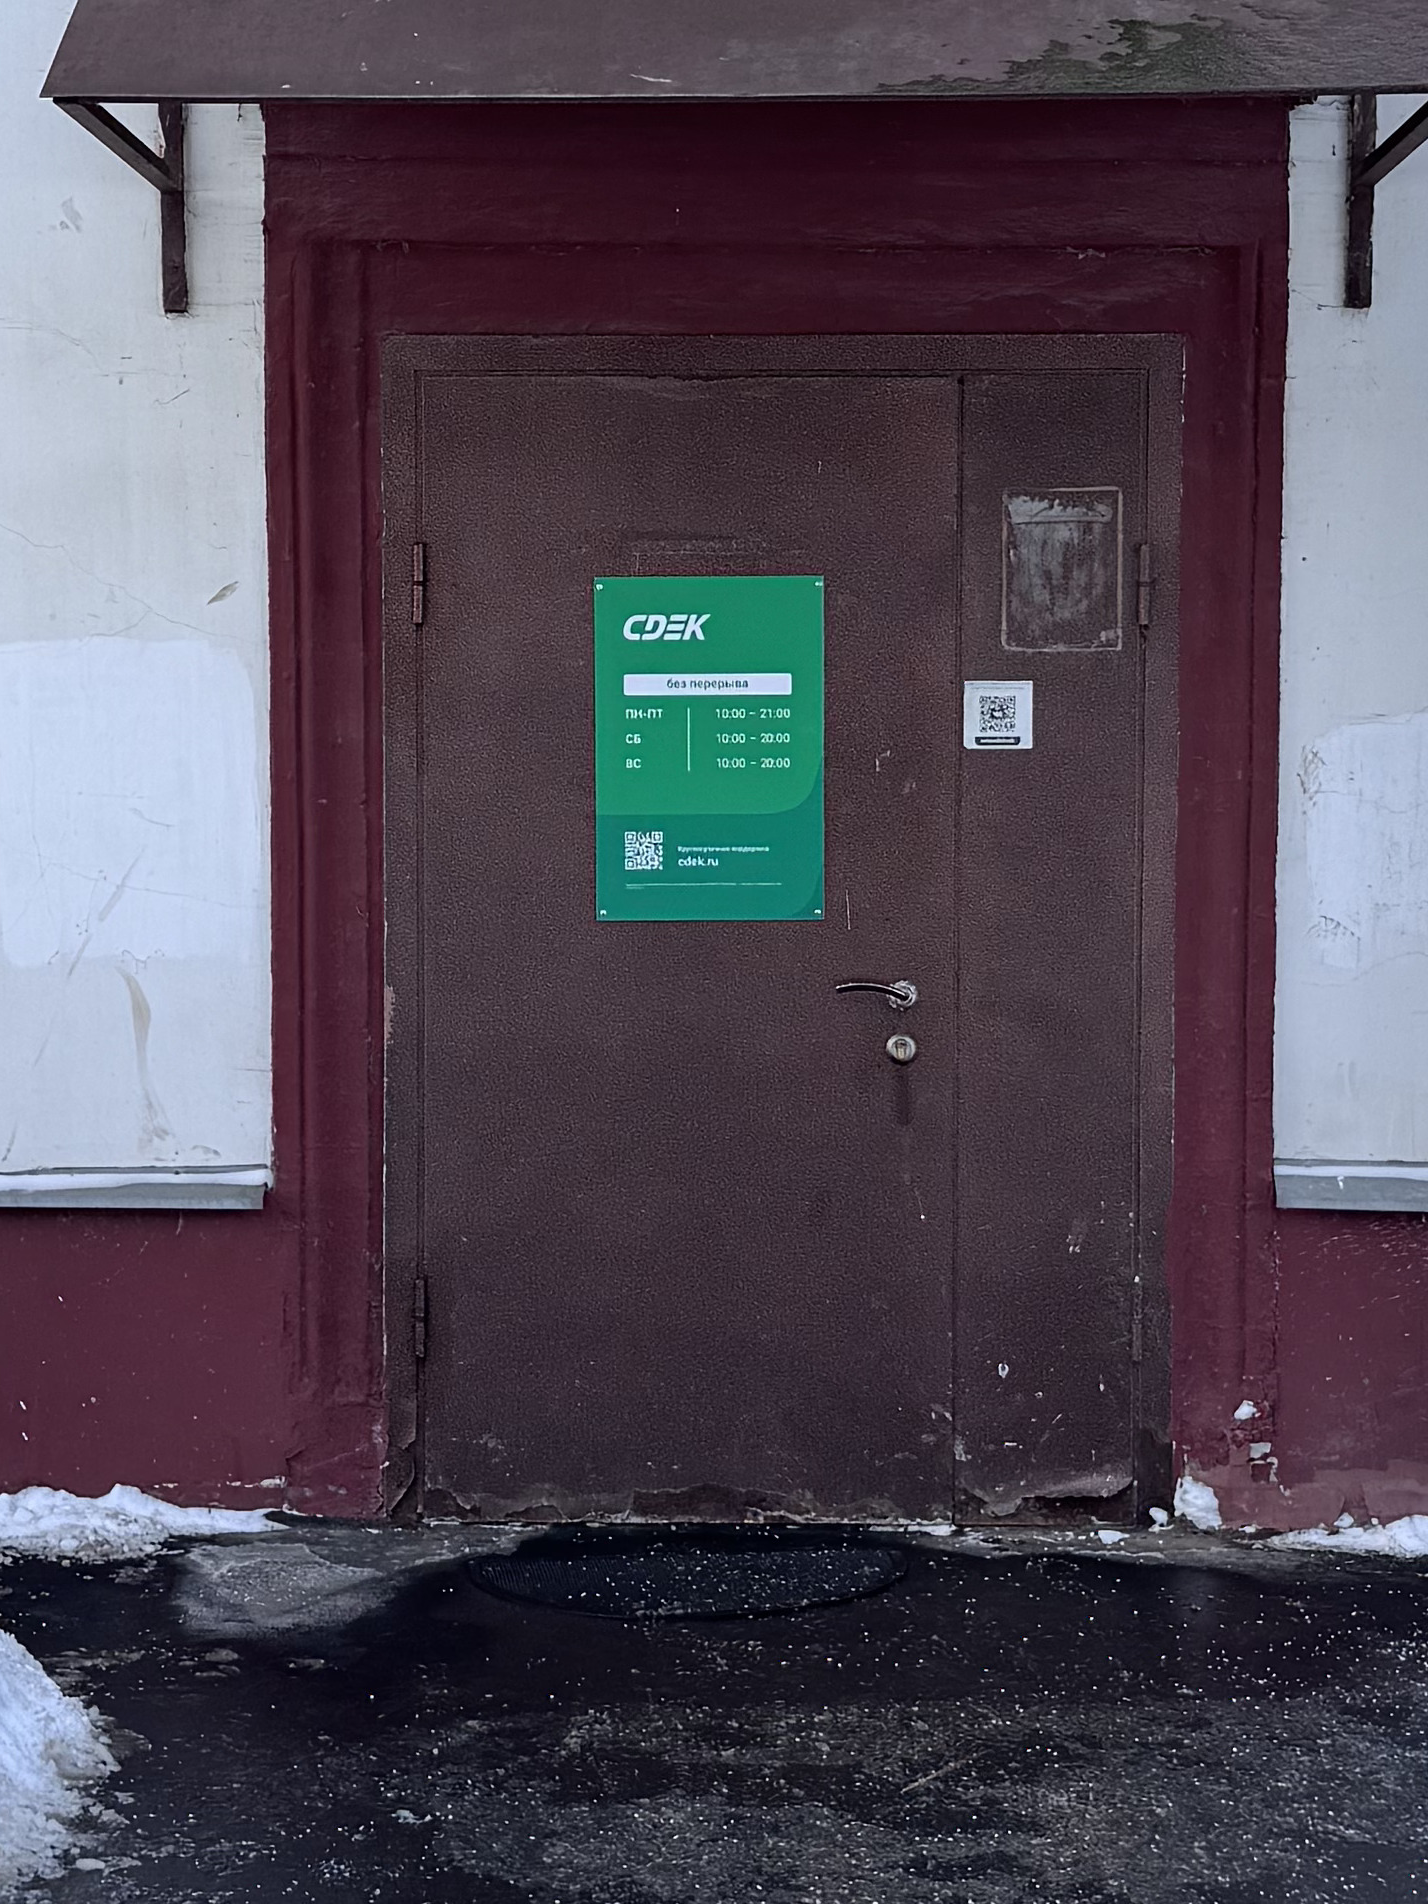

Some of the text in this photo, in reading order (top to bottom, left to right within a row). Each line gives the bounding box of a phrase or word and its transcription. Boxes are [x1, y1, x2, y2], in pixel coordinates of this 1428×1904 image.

[623, 614, 711, 641] CDEK
[666, 677, 749, 691] без перерыва
[715, 708, 746, 719] 10:00
[759, 708, 791, 719] 21:00
[625, 733, 642, 744] СБ
[715, 733, 746, 744] 10:00
[760, 733, 791, 744] 20:00
[625, 758, 642, 769] ВС
[715, 757, 746, 769] 10:00
[760, 757, 791, 769] 20:00
[677, 855, 720, 867] cdek.ru
